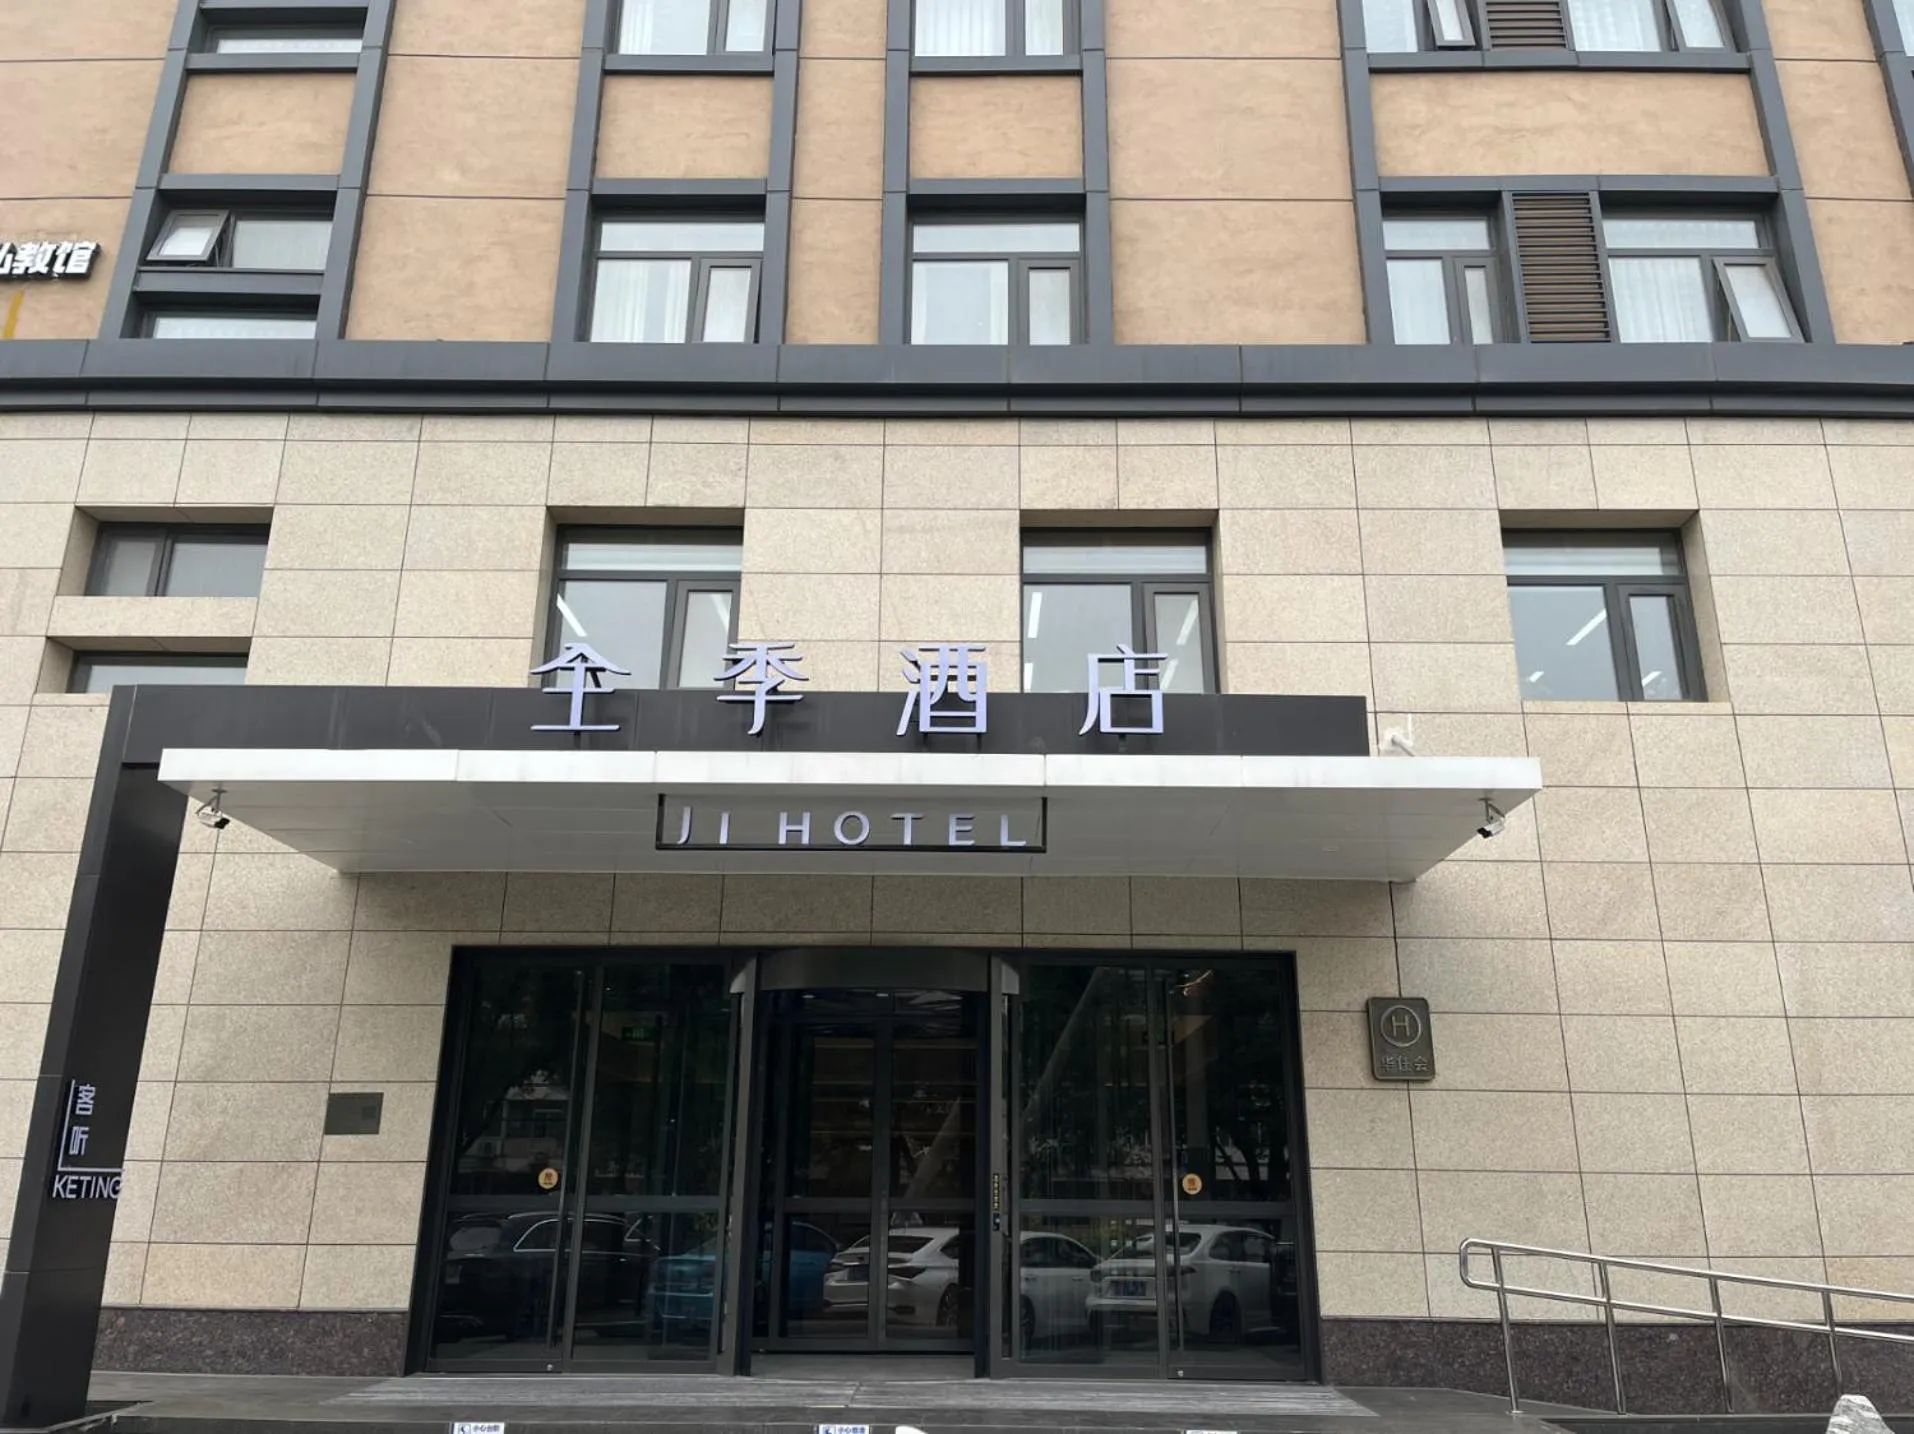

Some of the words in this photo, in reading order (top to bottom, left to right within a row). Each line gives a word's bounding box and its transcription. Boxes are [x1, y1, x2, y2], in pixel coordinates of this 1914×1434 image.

[530, 643, 1168, 736] 全季酒店
[677, 806, 730, 846] JI
[778, 811, 1027, 847] HOTEL
[1381, 1055, 1429, 1072] 华住会
[52, 1174, 123, 1198] KETING
